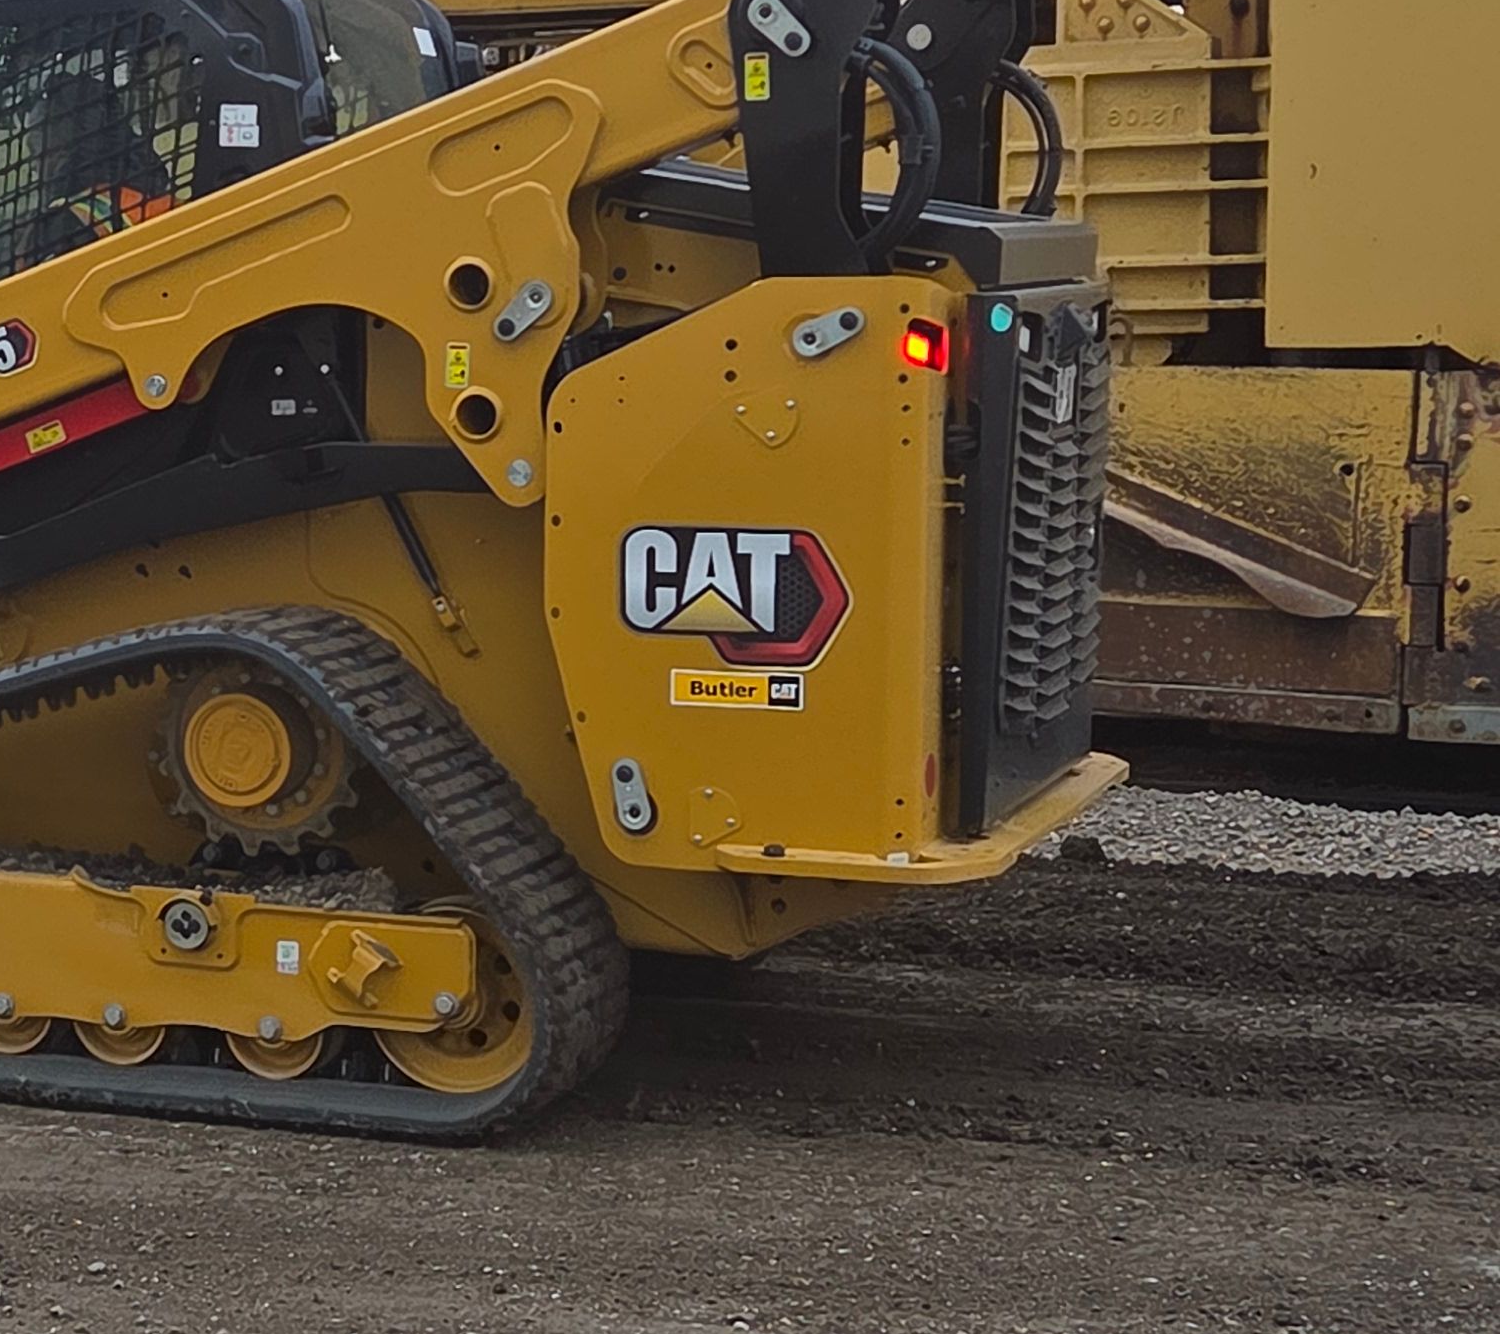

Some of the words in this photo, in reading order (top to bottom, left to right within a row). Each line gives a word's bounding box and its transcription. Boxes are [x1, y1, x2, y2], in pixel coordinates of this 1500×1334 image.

[625, 528, 791, 633] CAT
[690, 680, 758, 698] Butler
[770, 683, 798, 700] CAT
